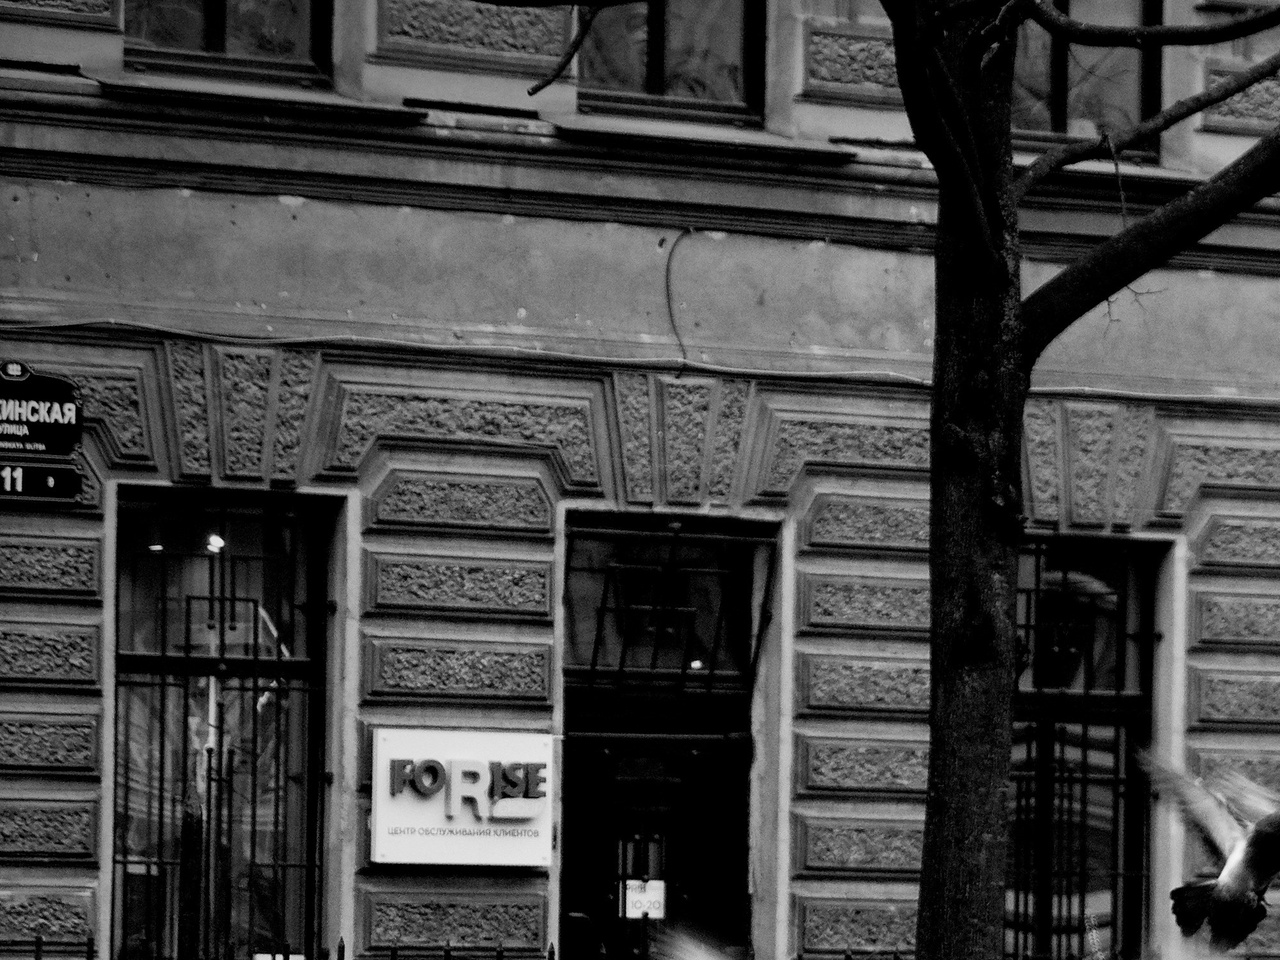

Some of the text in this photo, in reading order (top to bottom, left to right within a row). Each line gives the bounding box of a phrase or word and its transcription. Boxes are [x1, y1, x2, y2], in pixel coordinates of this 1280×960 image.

[1, 466, 23, 492] 11
[390, 759, 547, 825] FORISE
[387, 826, 540, 838] ЦЕНТР ОБСЛУЖИВАНИЯ КЛИЕНТОВ
